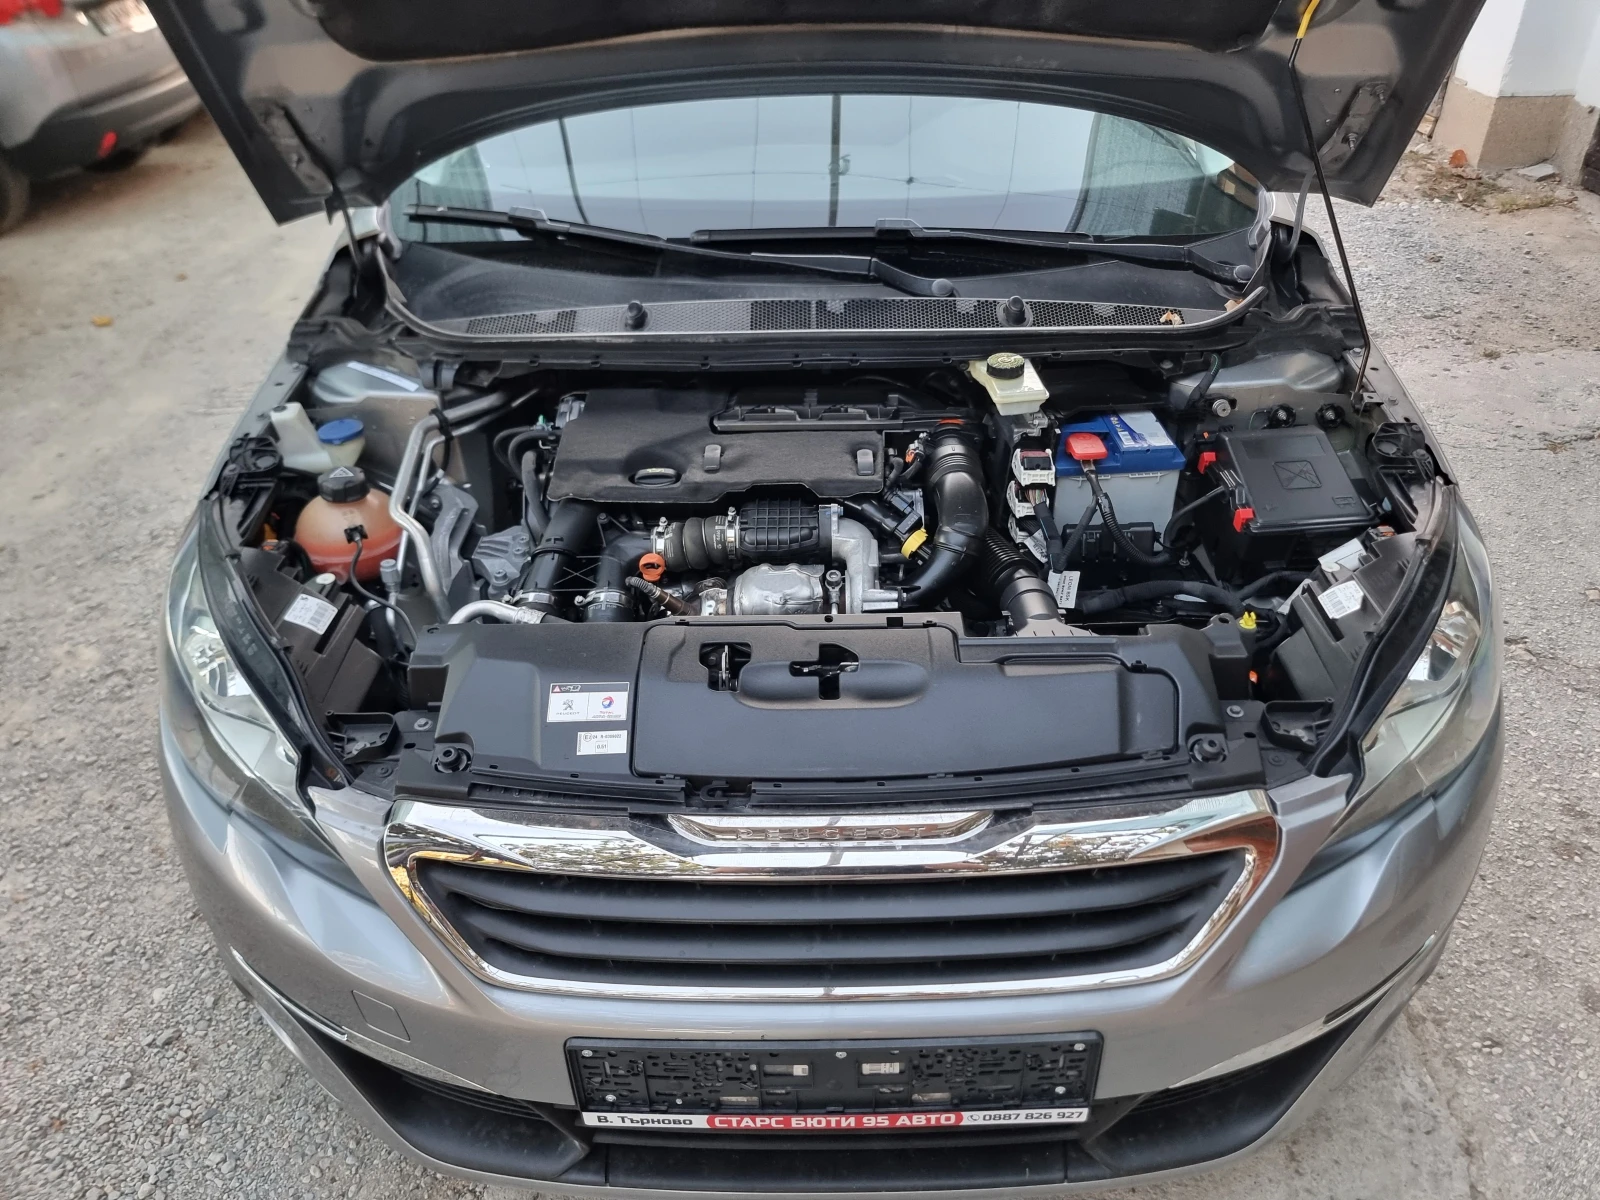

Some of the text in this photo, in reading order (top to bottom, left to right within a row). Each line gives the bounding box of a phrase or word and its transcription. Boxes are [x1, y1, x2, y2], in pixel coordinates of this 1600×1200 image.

[736, 826, 926, 841] PEUGEOT
[596, 1115, 693, 1126] В. Търново
[714, 1113, 956, 1128] СТАРС БЮТИ 95 АВТО
[982, 1110, 1084, 1122] 0887 826 927
